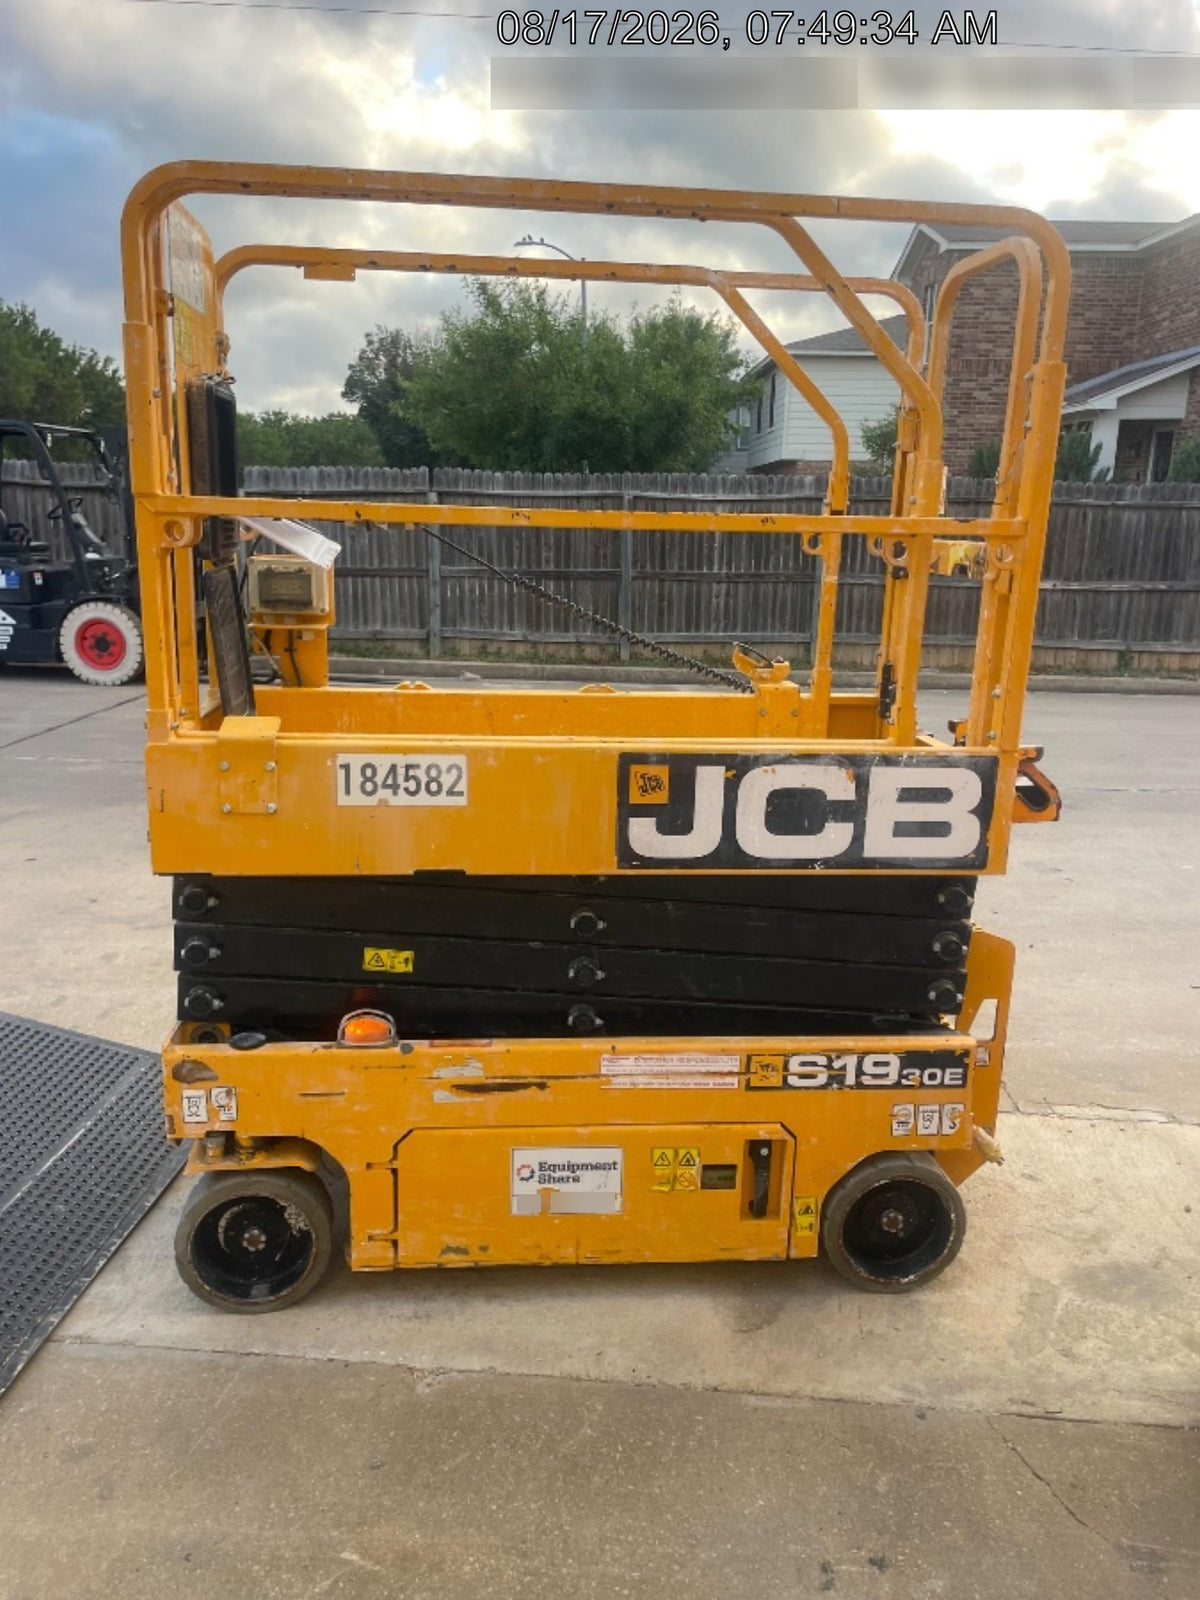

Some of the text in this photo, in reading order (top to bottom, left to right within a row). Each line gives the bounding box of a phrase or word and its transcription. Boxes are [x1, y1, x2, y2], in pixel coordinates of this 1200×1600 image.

[339, 763, 464, 797] 184582
[628, 764, 982, 859] JCB
[787, 1053, 900, 1087] S19
[538, 1161, 618, 1174] Equipment
[538, 1173, 580, 1185] Share
